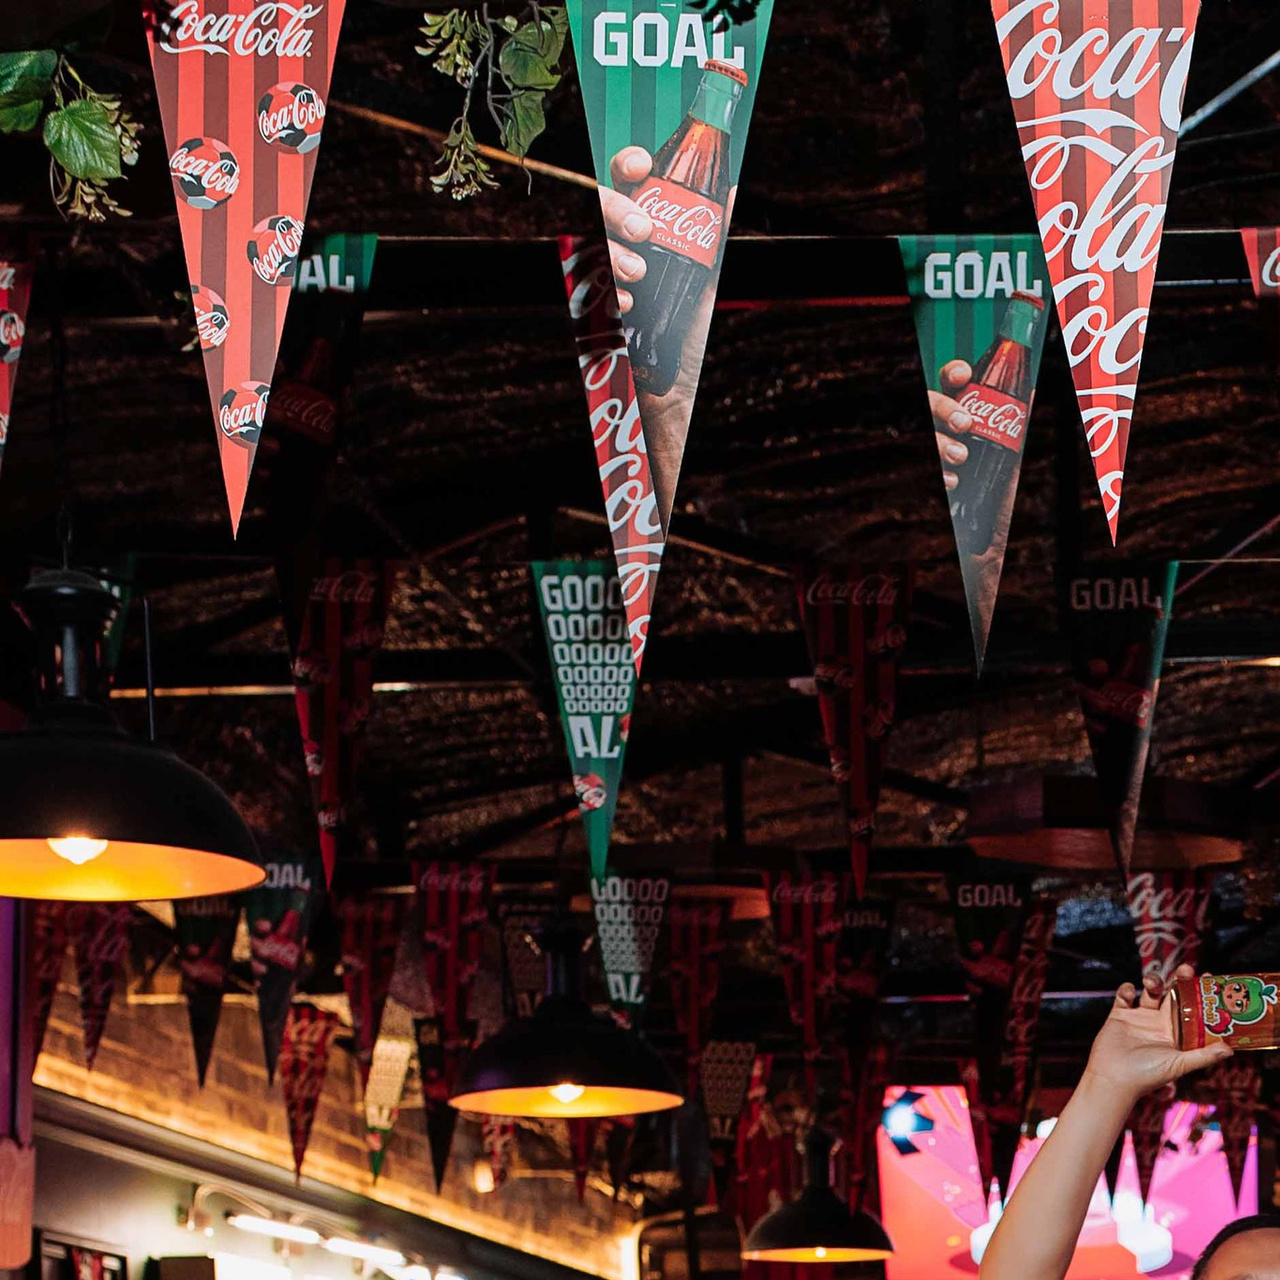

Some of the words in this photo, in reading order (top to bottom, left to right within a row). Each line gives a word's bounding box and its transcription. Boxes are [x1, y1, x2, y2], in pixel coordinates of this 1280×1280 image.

[593, 12, 744, 69] GOAL
[634, 187, 723, 249] Coca-Cola
[657, 233, 690, 251] CLASSIC
[924, 251, 1042, 299] GOAL
[958, 390, 1026, 438] Coca-Cola
[1071, 577, 1161, 612] GOAL
[567, 715, 621, 759] AL
[957, 883, 1023, 908] GOAL
[607, 973, 645, 1004] AL
